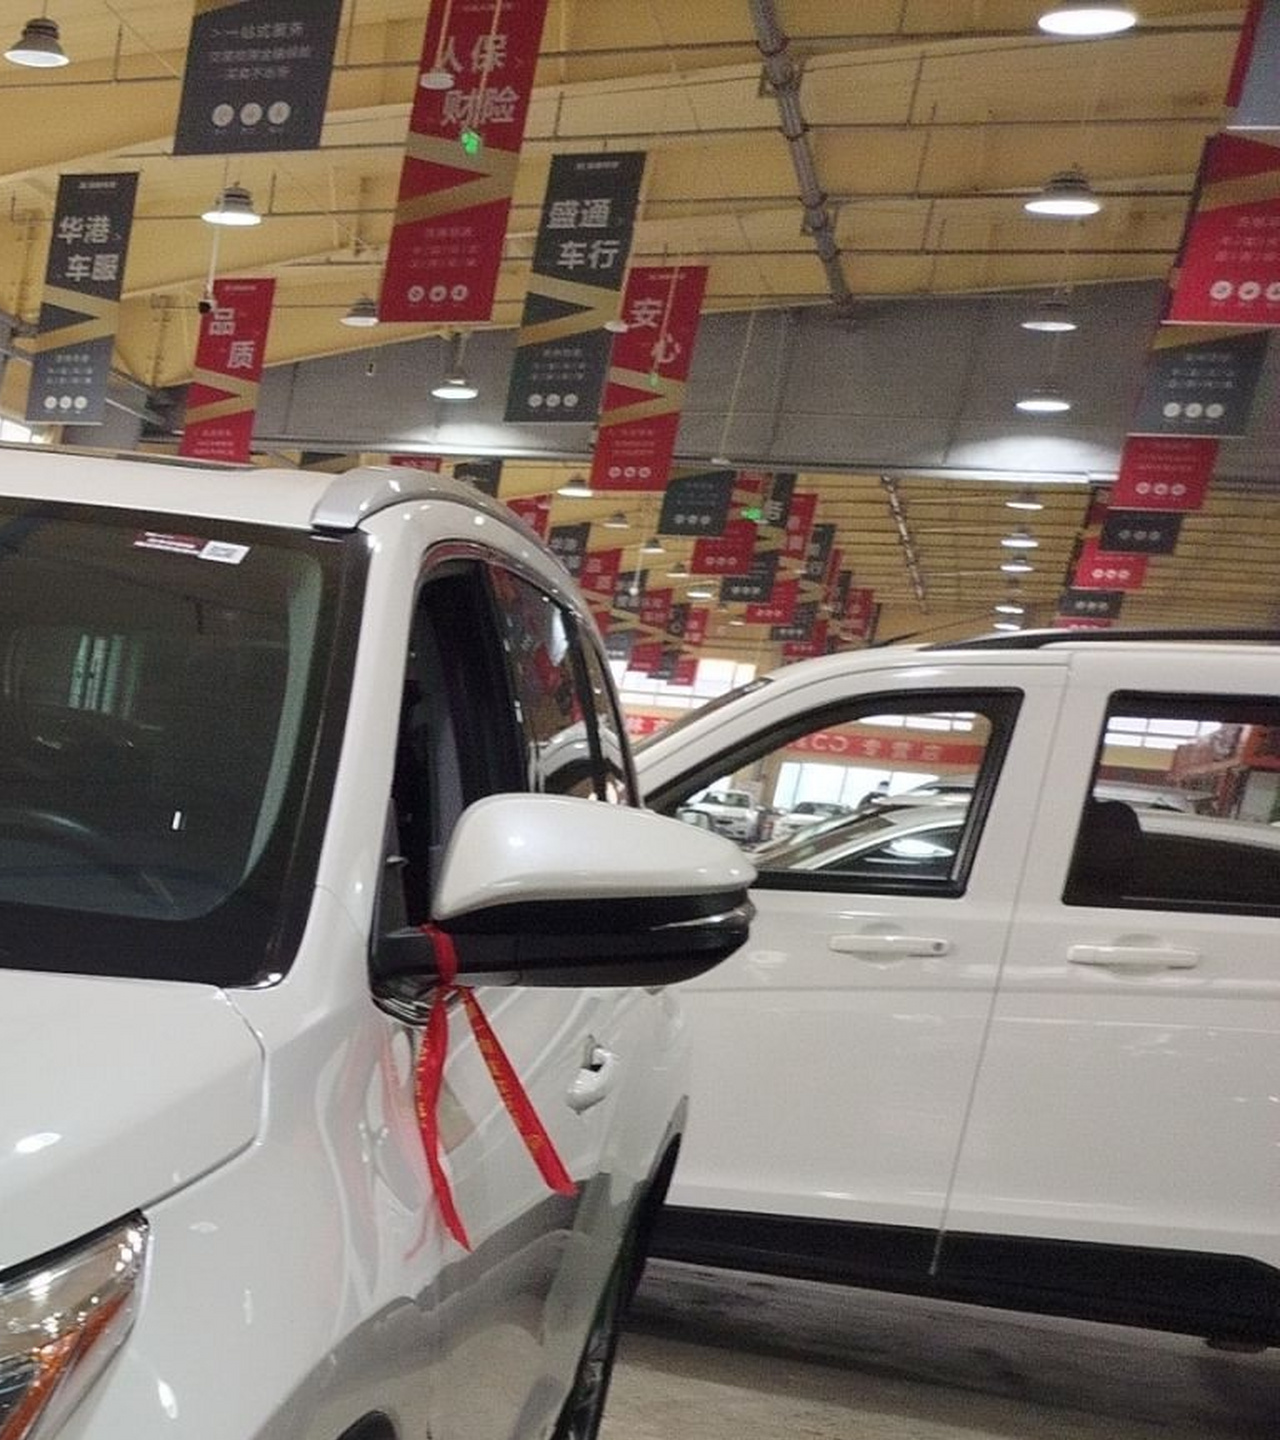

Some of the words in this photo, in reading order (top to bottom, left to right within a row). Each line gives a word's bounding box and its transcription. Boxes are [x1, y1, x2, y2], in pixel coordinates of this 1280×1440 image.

[437, 34, 508, 74] 人保
[441, 85, 520, 126] 财险
[57, 214, 111, 244] 华港
[556, 240, 621, 269] 车行
